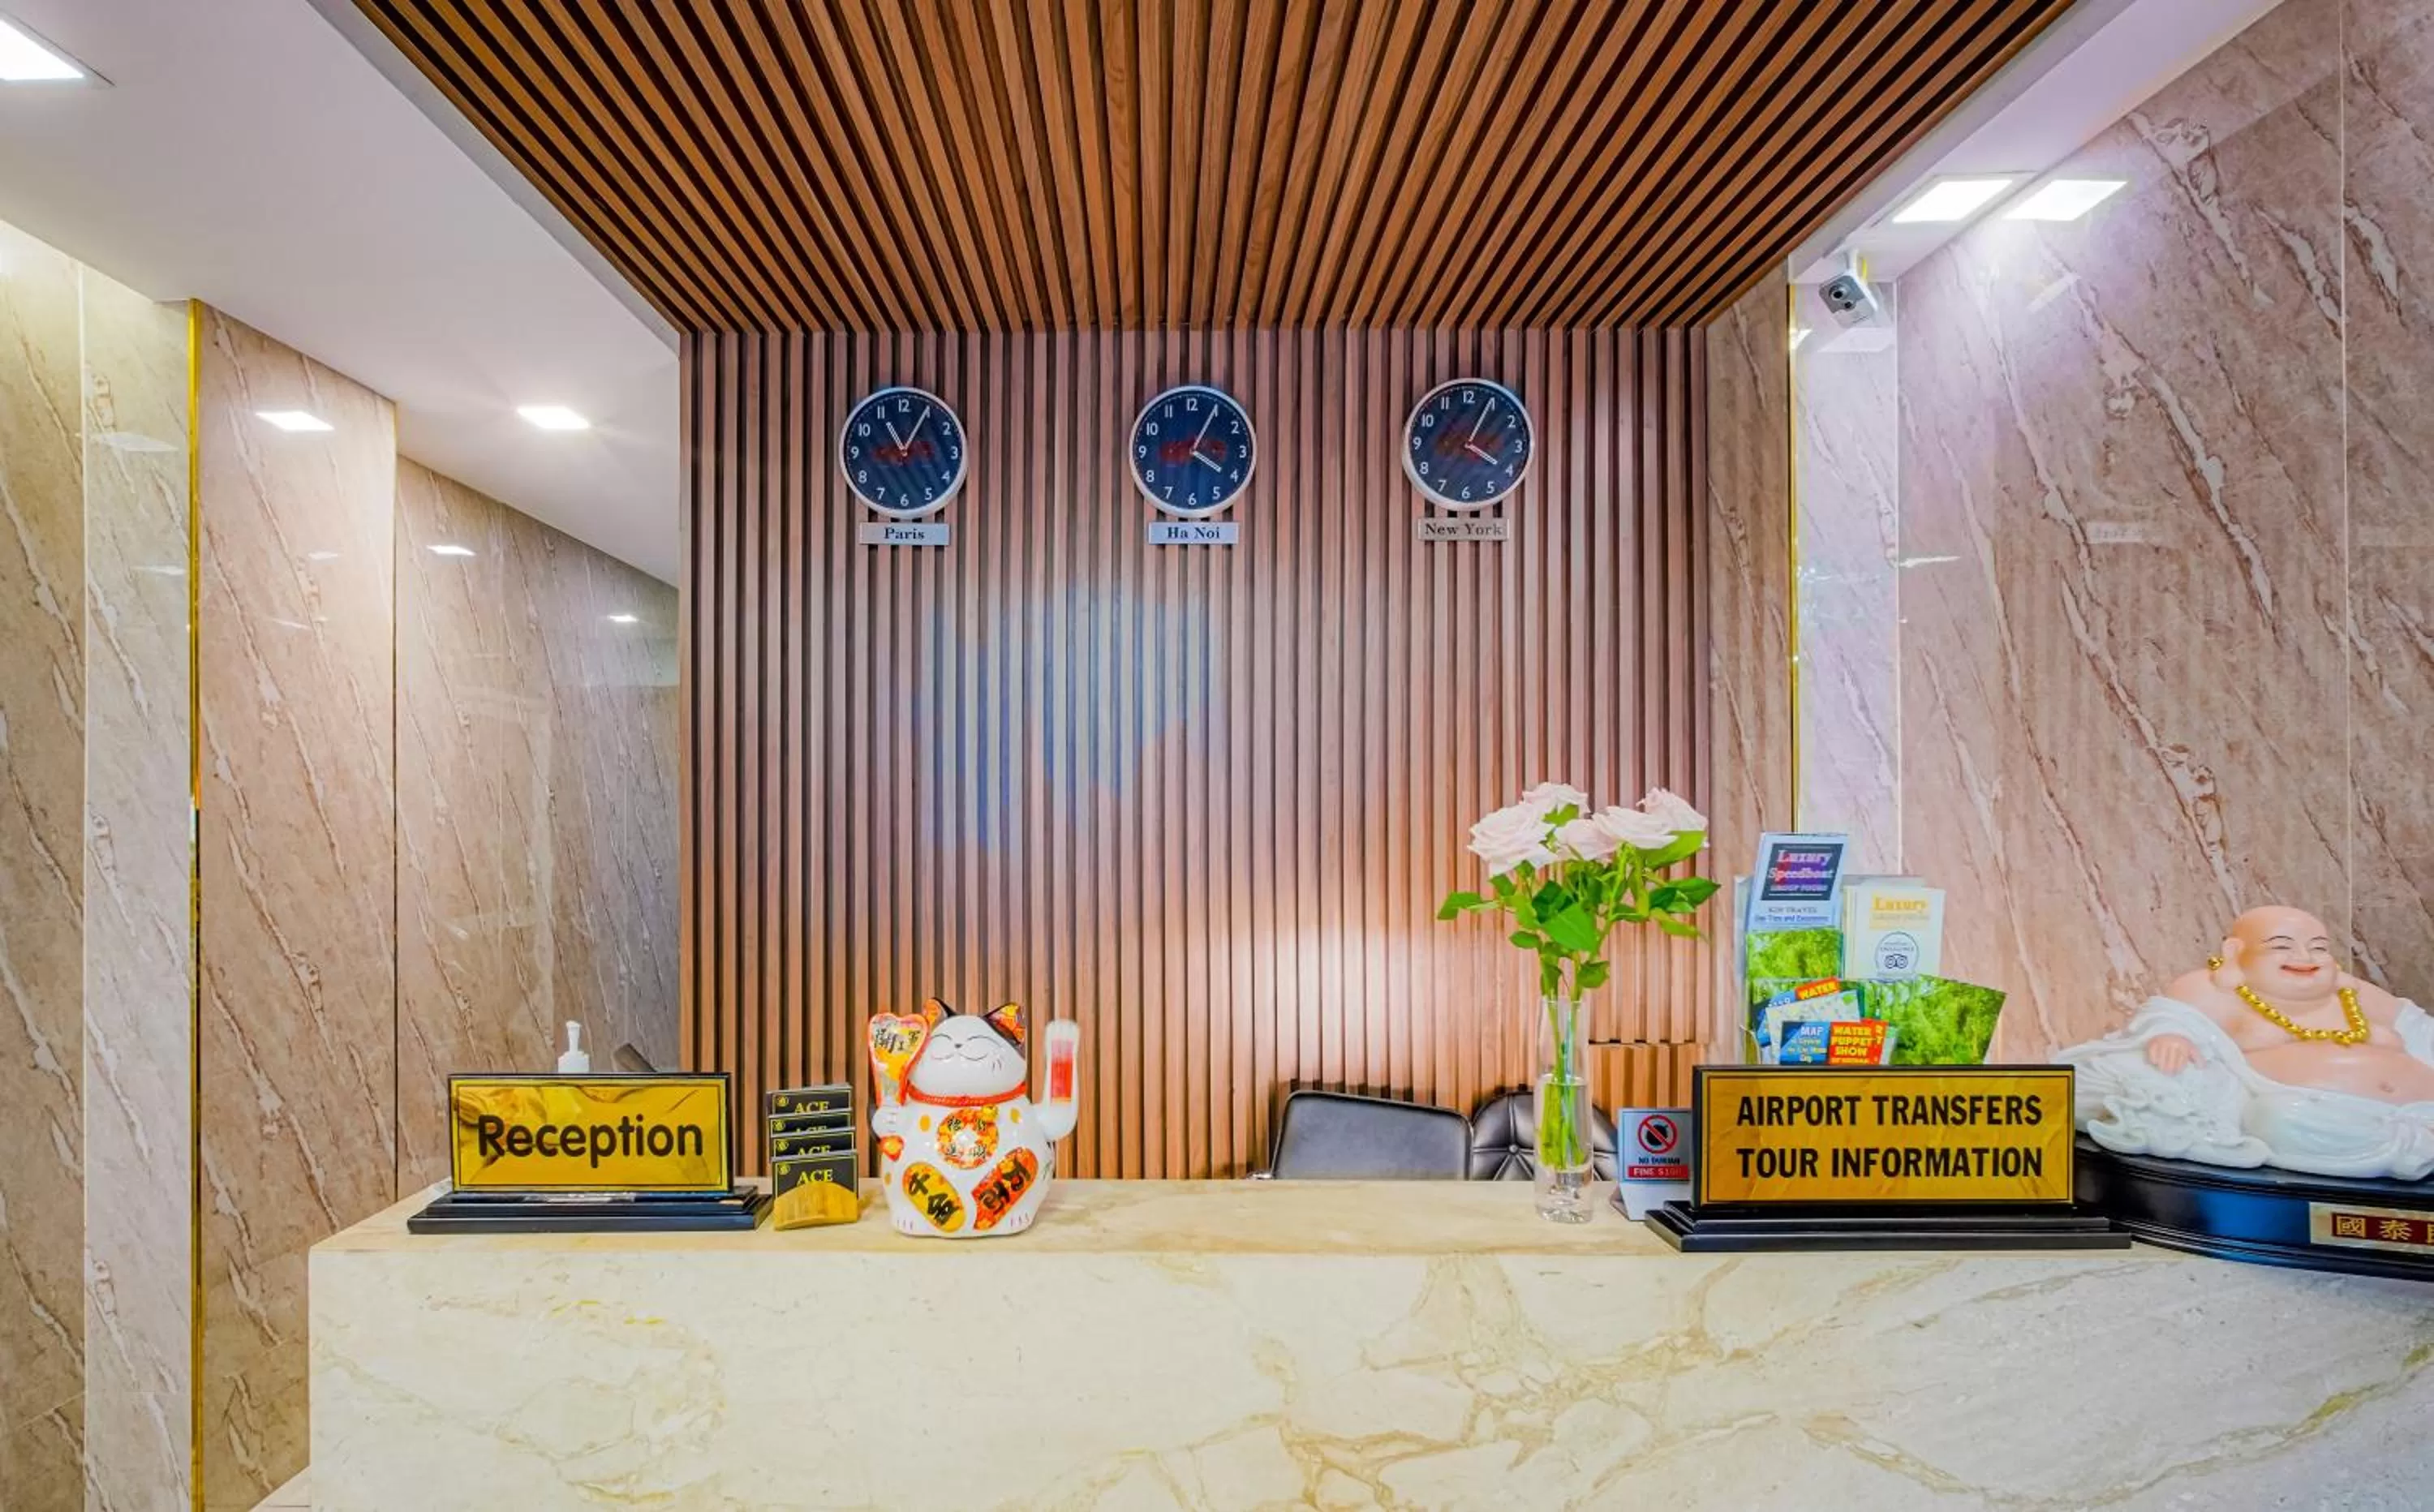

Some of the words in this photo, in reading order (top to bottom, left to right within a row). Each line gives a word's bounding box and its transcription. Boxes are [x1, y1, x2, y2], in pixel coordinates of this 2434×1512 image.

[1440, 397, 1449, 410] 11
[1463, 391, 1475, 404] 12
[898, 399, 910, 412] 12
[1186, 398, 1198, 411] 12
[877, 406, 885, 419] 11
[1164, 406, 1173, 418] 11
[1421, 415, 1434, 427] 10
[1507, 415, 1516, 427] 2
[858, 423, 871, 436] 10
[943, 423, 952, 436] 2
[1146, 423, 1159, 436] 10
[1232, 422, 1240, 434] 2
[1413, 437, 1421, 449] 9
[1515, 441, 1522, 453] 3
[851, 447, 859, 458] 9
[951, 447, 958, 459] 3
[1138, 446, 1146, 458] 9
[1239, 446, 1246, 458] 3
[1419, 462, 1429, 475] 8
[1505, 464, 1513, 477] 4
[858, 470, 867, 484] 8
[941, 470, 950, 484] 4
[1146, 470, 1155, 483] 8
[1230, 470, 1239, 483] 4
[1438, 480, 1447, 492] 7
[1486, 481, 1494, 494] 5
[876, 488, 885, 500] 7
[925, 488, 932, 500] 5
[1165, 487, 1173, 500] 7
[1188, 492, 1197, 505] 6
[1213, 487, 1220, 500] 5
[1462, 487, 1470, 499] 6
[901, 494, 909, 506] 6
[884, 528, 925, 539] Paris
[1168, 527, 1188, 539] Ha
[1194, 527, 1220, 539] Noi
[1425, 523, 1459, 535] New
[1464, 523, 1503, 535] York
[1778, 849, 1833, 866] Luxury
[1800, 1026, 1824, 1036] MAP
[1833, 1026, 1872, 1036] WATER
[1831, 1037, 1873, 1046] PUPPET
[1834, 1047, 1868, 1056] SHOW
[794, 1101, 831, 1114] ACE
[1736, 1095, 1862, 1126] AIRPORT
[1873, 1094, 2042, 1126] TRANSFERS
[476, 1114, 703, 1169] Reception
[1736, 1147, 1819, 1178] TOUR
[1831, 1146, 2042, 1178] INFORMATION
[796, 1169, 833, 1186] ACE
[1633, 1168, 1655, 1176] FINE
